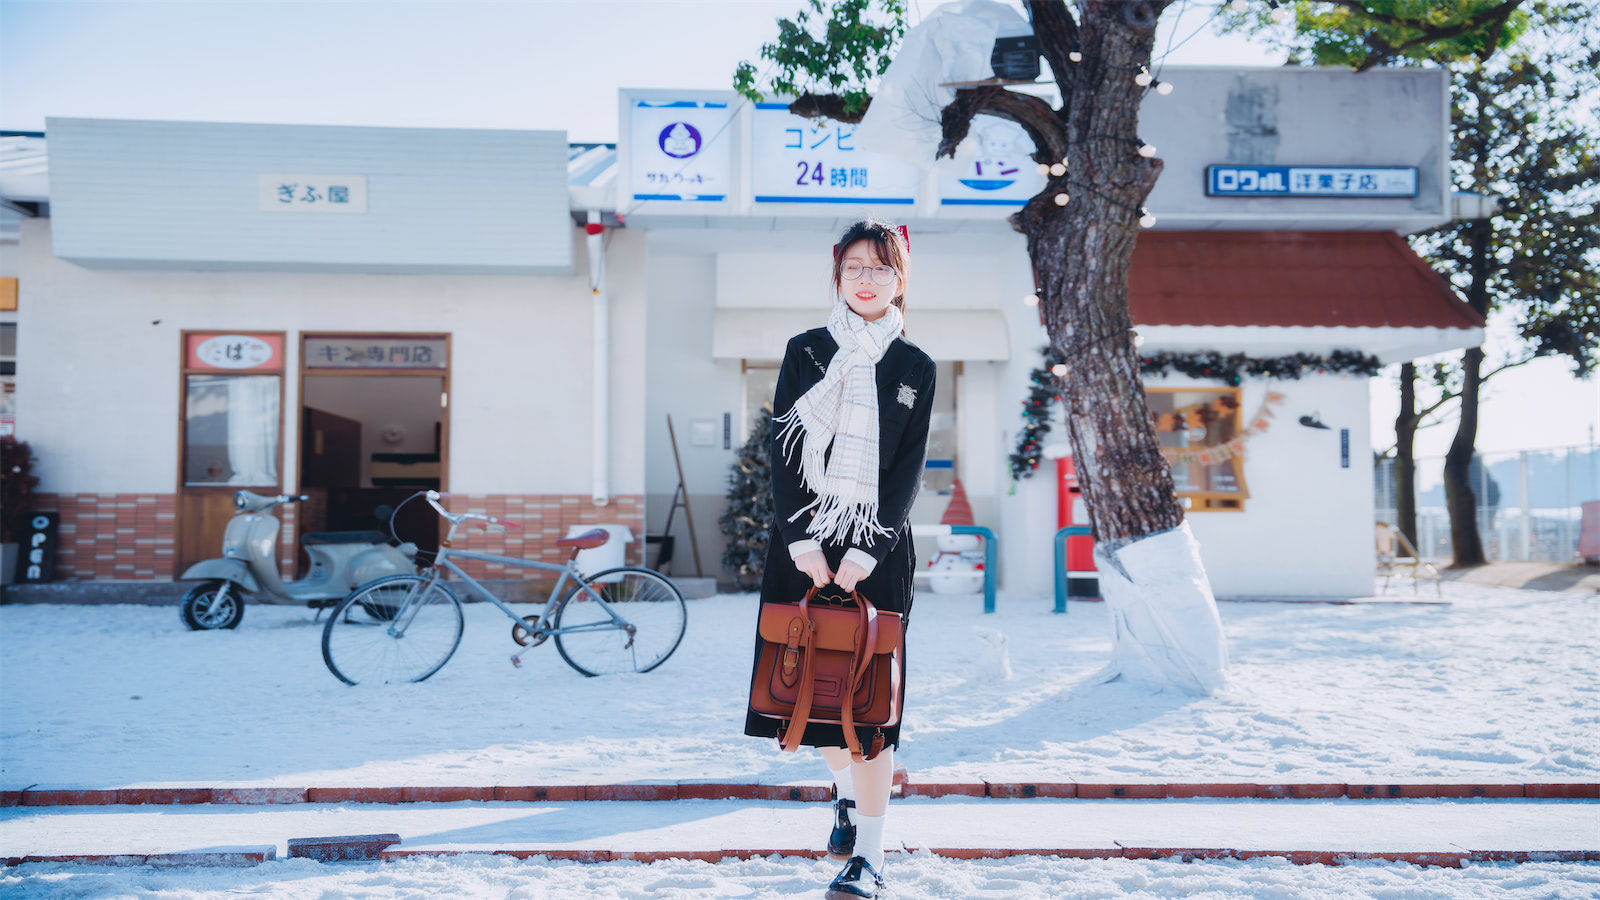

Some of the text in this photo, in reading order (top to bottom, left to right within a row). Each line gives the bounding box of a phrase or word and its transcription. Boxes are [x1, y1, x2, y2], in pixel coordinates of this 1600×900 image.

[785, 126, 866, 151] コンビ
[796, 161, 868, 188] 24時間
[278, 184, 349, 203] ぎふ屋
[205, 340, 264, 362] たばこ
